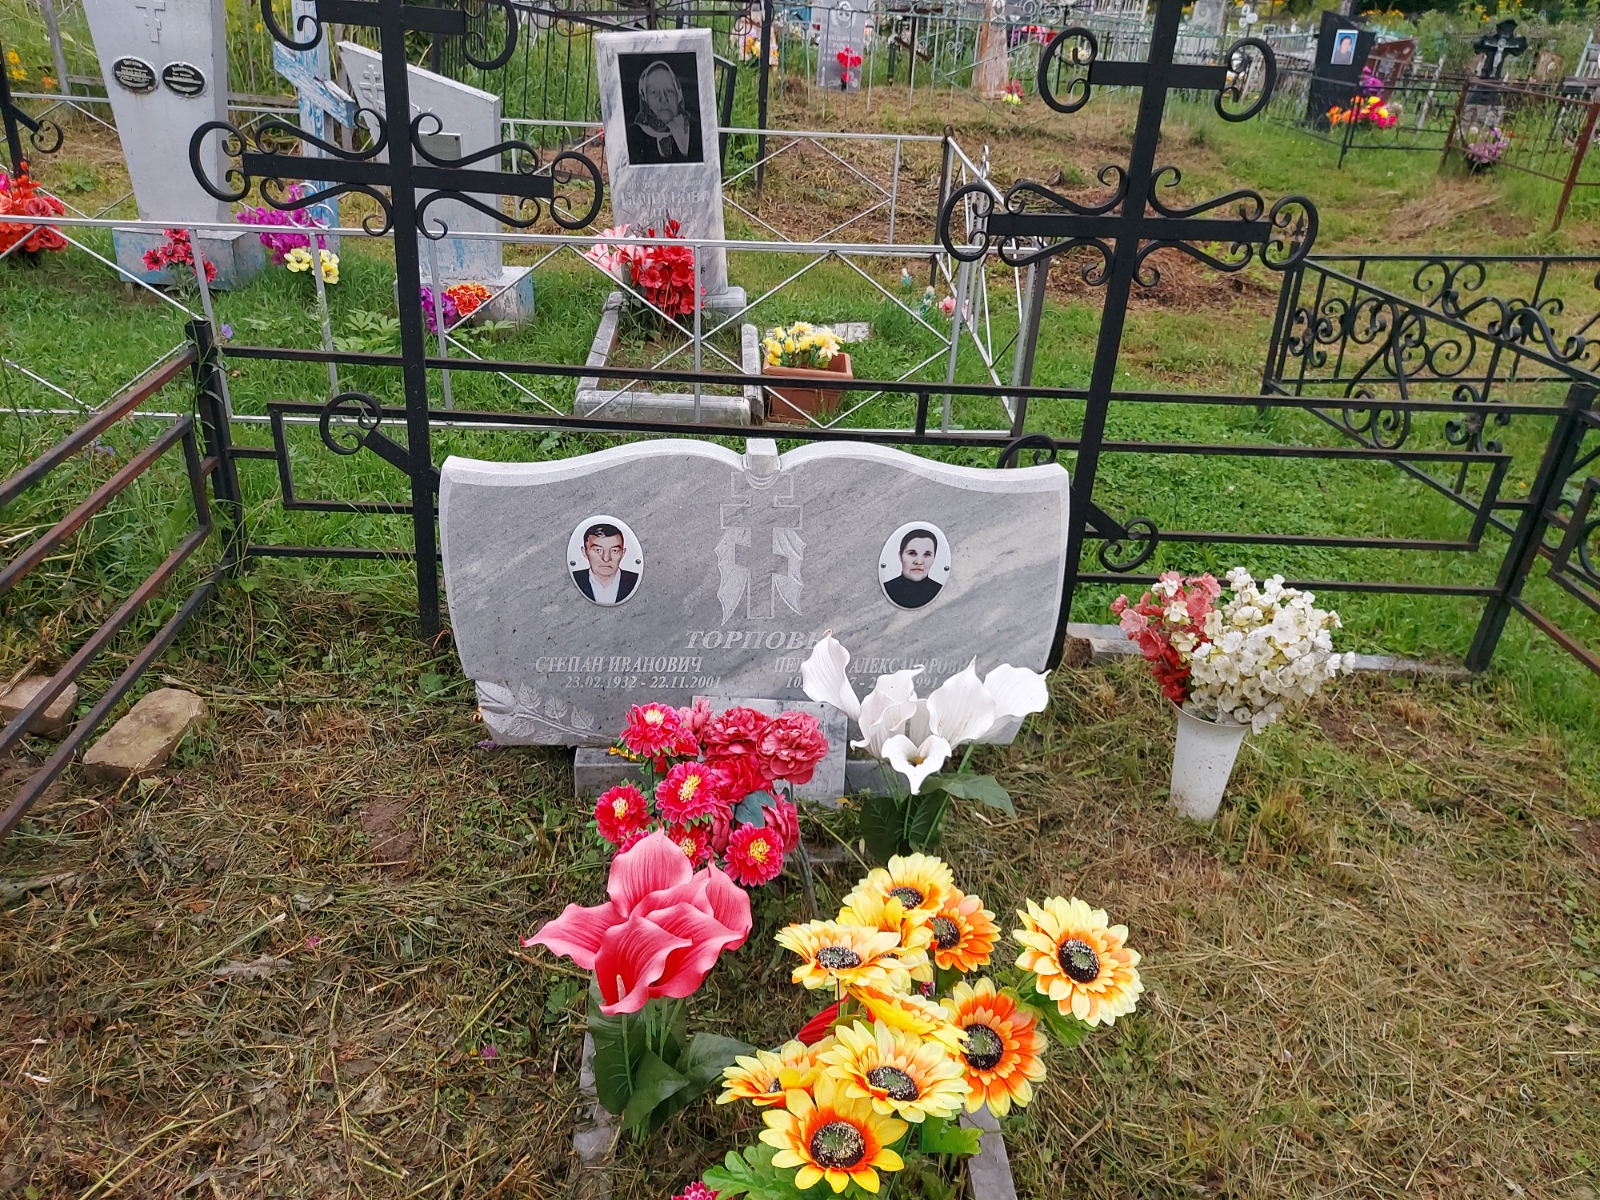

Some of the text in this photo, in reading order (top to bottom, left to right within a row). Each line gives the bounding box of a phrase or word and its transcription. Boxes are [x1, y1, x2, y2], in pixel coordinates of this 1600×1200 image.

[535, 656, 704, 673] СТЕПАН ИВАНОВИЧ
[565, 675, 637, 689] 23.02.1932
[650, 675, 721, 689] 22.11.2001
